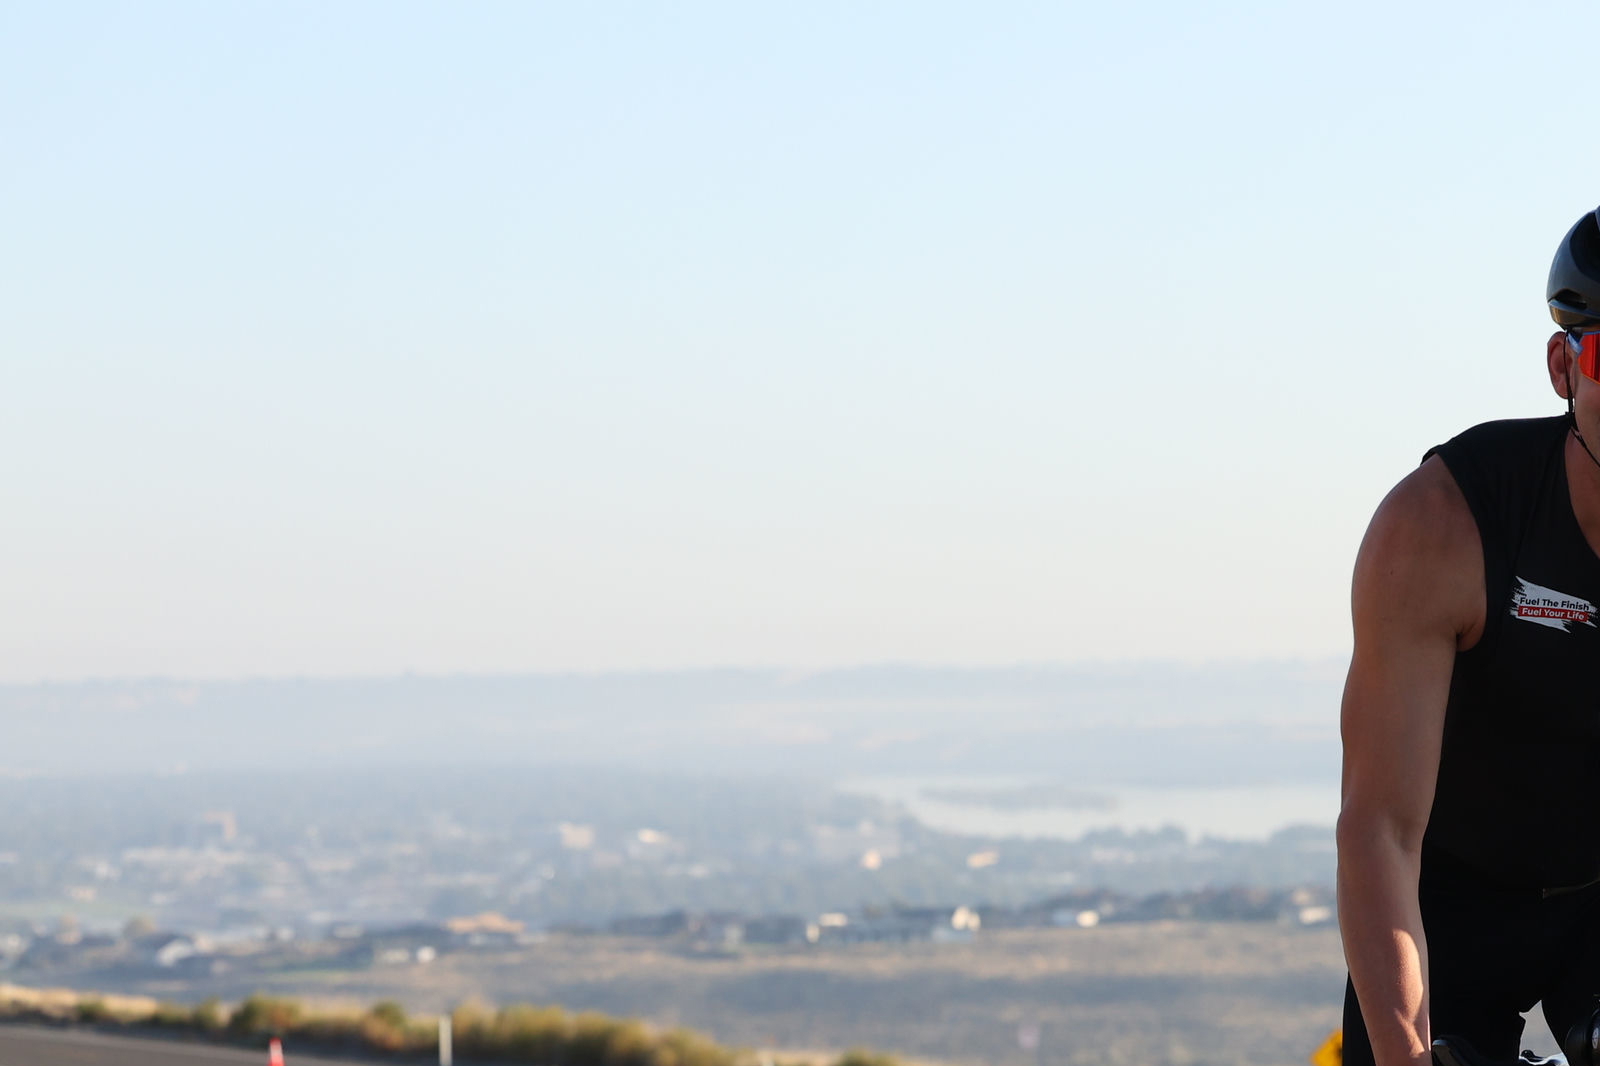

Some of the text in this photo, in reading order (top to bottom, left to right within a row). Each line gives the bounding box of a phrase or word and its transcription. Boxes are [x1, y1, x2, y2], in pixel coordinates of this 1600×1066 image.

[1520, 597, 1590, 611] Fuel The Finish
[1522, 608, 1585, 620] Fuel Your Life
